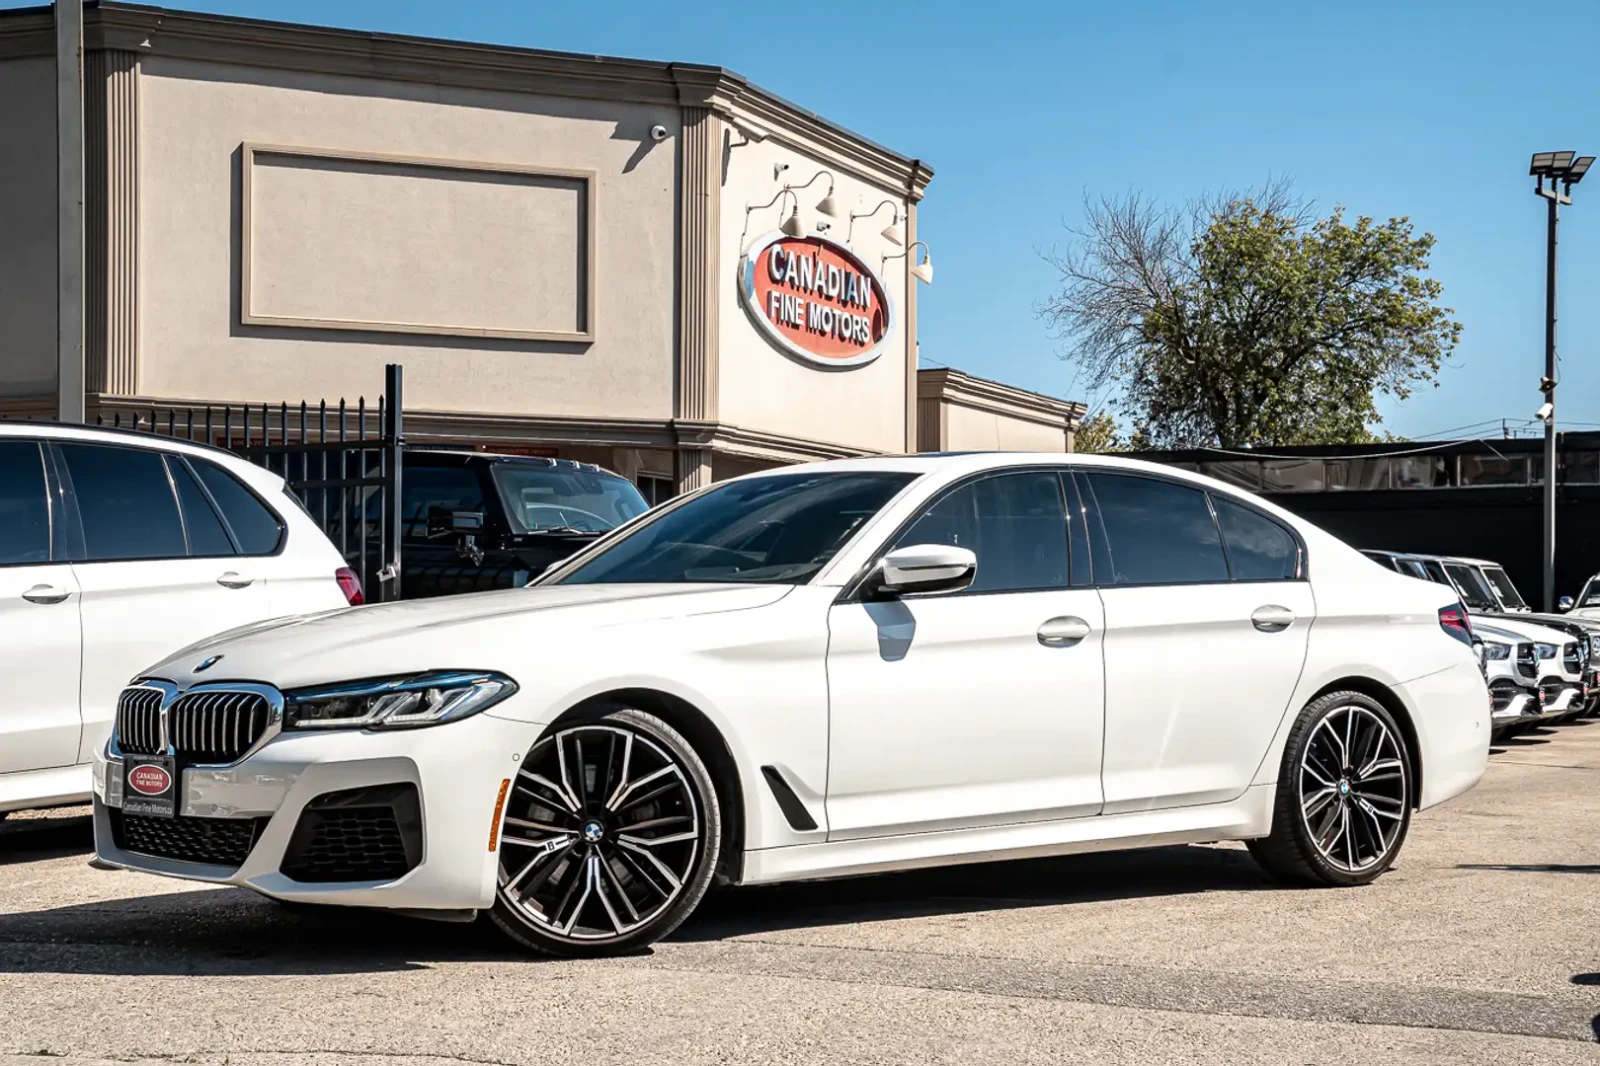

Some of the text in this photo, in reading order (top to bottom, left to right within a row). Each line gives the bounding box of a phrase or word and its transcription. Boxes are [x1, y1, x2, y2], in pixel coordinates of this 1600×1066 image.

[769, 244, 871, 309] CANADIAN
[769, 290, 870, 344] FINE MOTORS
[136, 772, 163, 781] CANADIAN
[146, 780, 163, 788] MOTORS
[123, 801, 142, 812] Canadian
